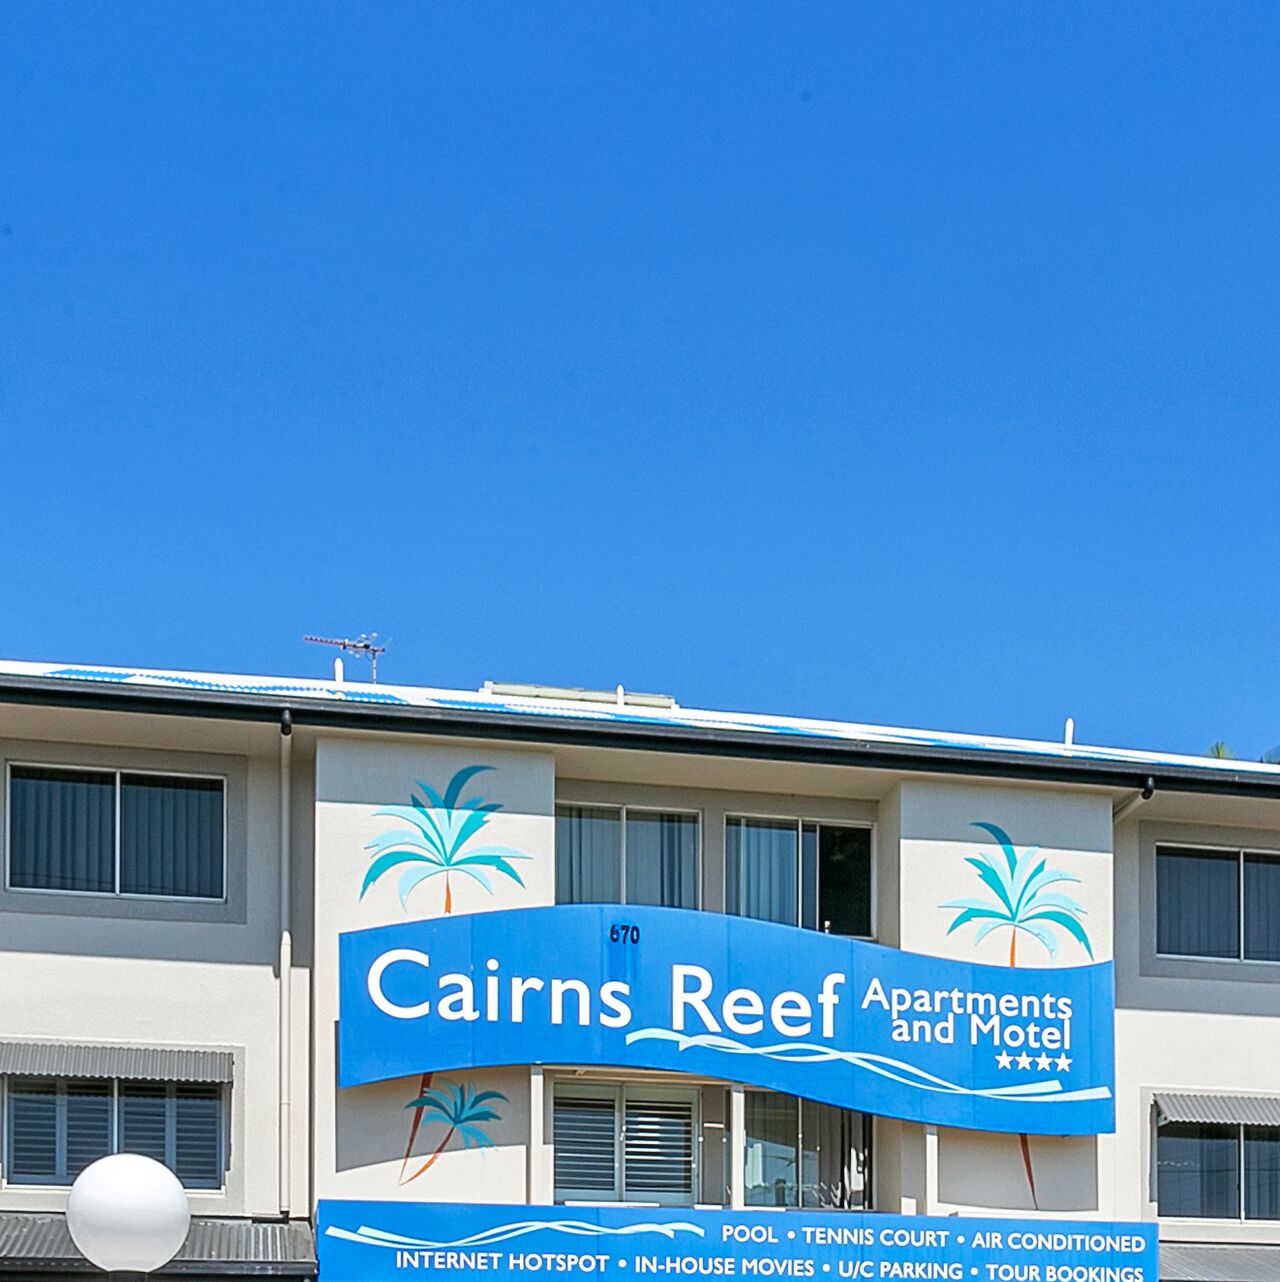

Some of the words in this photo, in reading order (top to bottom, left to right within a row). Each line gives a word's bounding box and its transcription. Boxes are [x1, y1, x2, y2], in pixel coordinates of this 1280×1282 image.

[610, 924, 640, 946] 670
[367, 949, 632, 1028] Cairns
[672, 963, 846, 1038] Reef
[861, 977, 1073, 1020] Apartments
[891, 1012, 954, 1044] and
[970, 1011, 1072, 1050] Motel
[722, 1224, 779, 1243] POOL
[801, 1226, 875, 1246] TENNIS
[879, 1229, 950, 1247] COURT
[971, 1231, 1003, 1249] AIR
[1007, 1232, 1146, 1253] CONDITIONED
[396, 1251, 503, 1270] INTERNET
[509, 1253, 610, 1273] HOTSPOT
[635, 1255, 735, 1275] IN-HOUSE
[741, 1258, 815, 1277] MOVIES
[838, 1260, 874, 1279] U/C
[880, 1261, 963, 1281] PARKING
[985, 1263, 1041, 1282] TOUR
